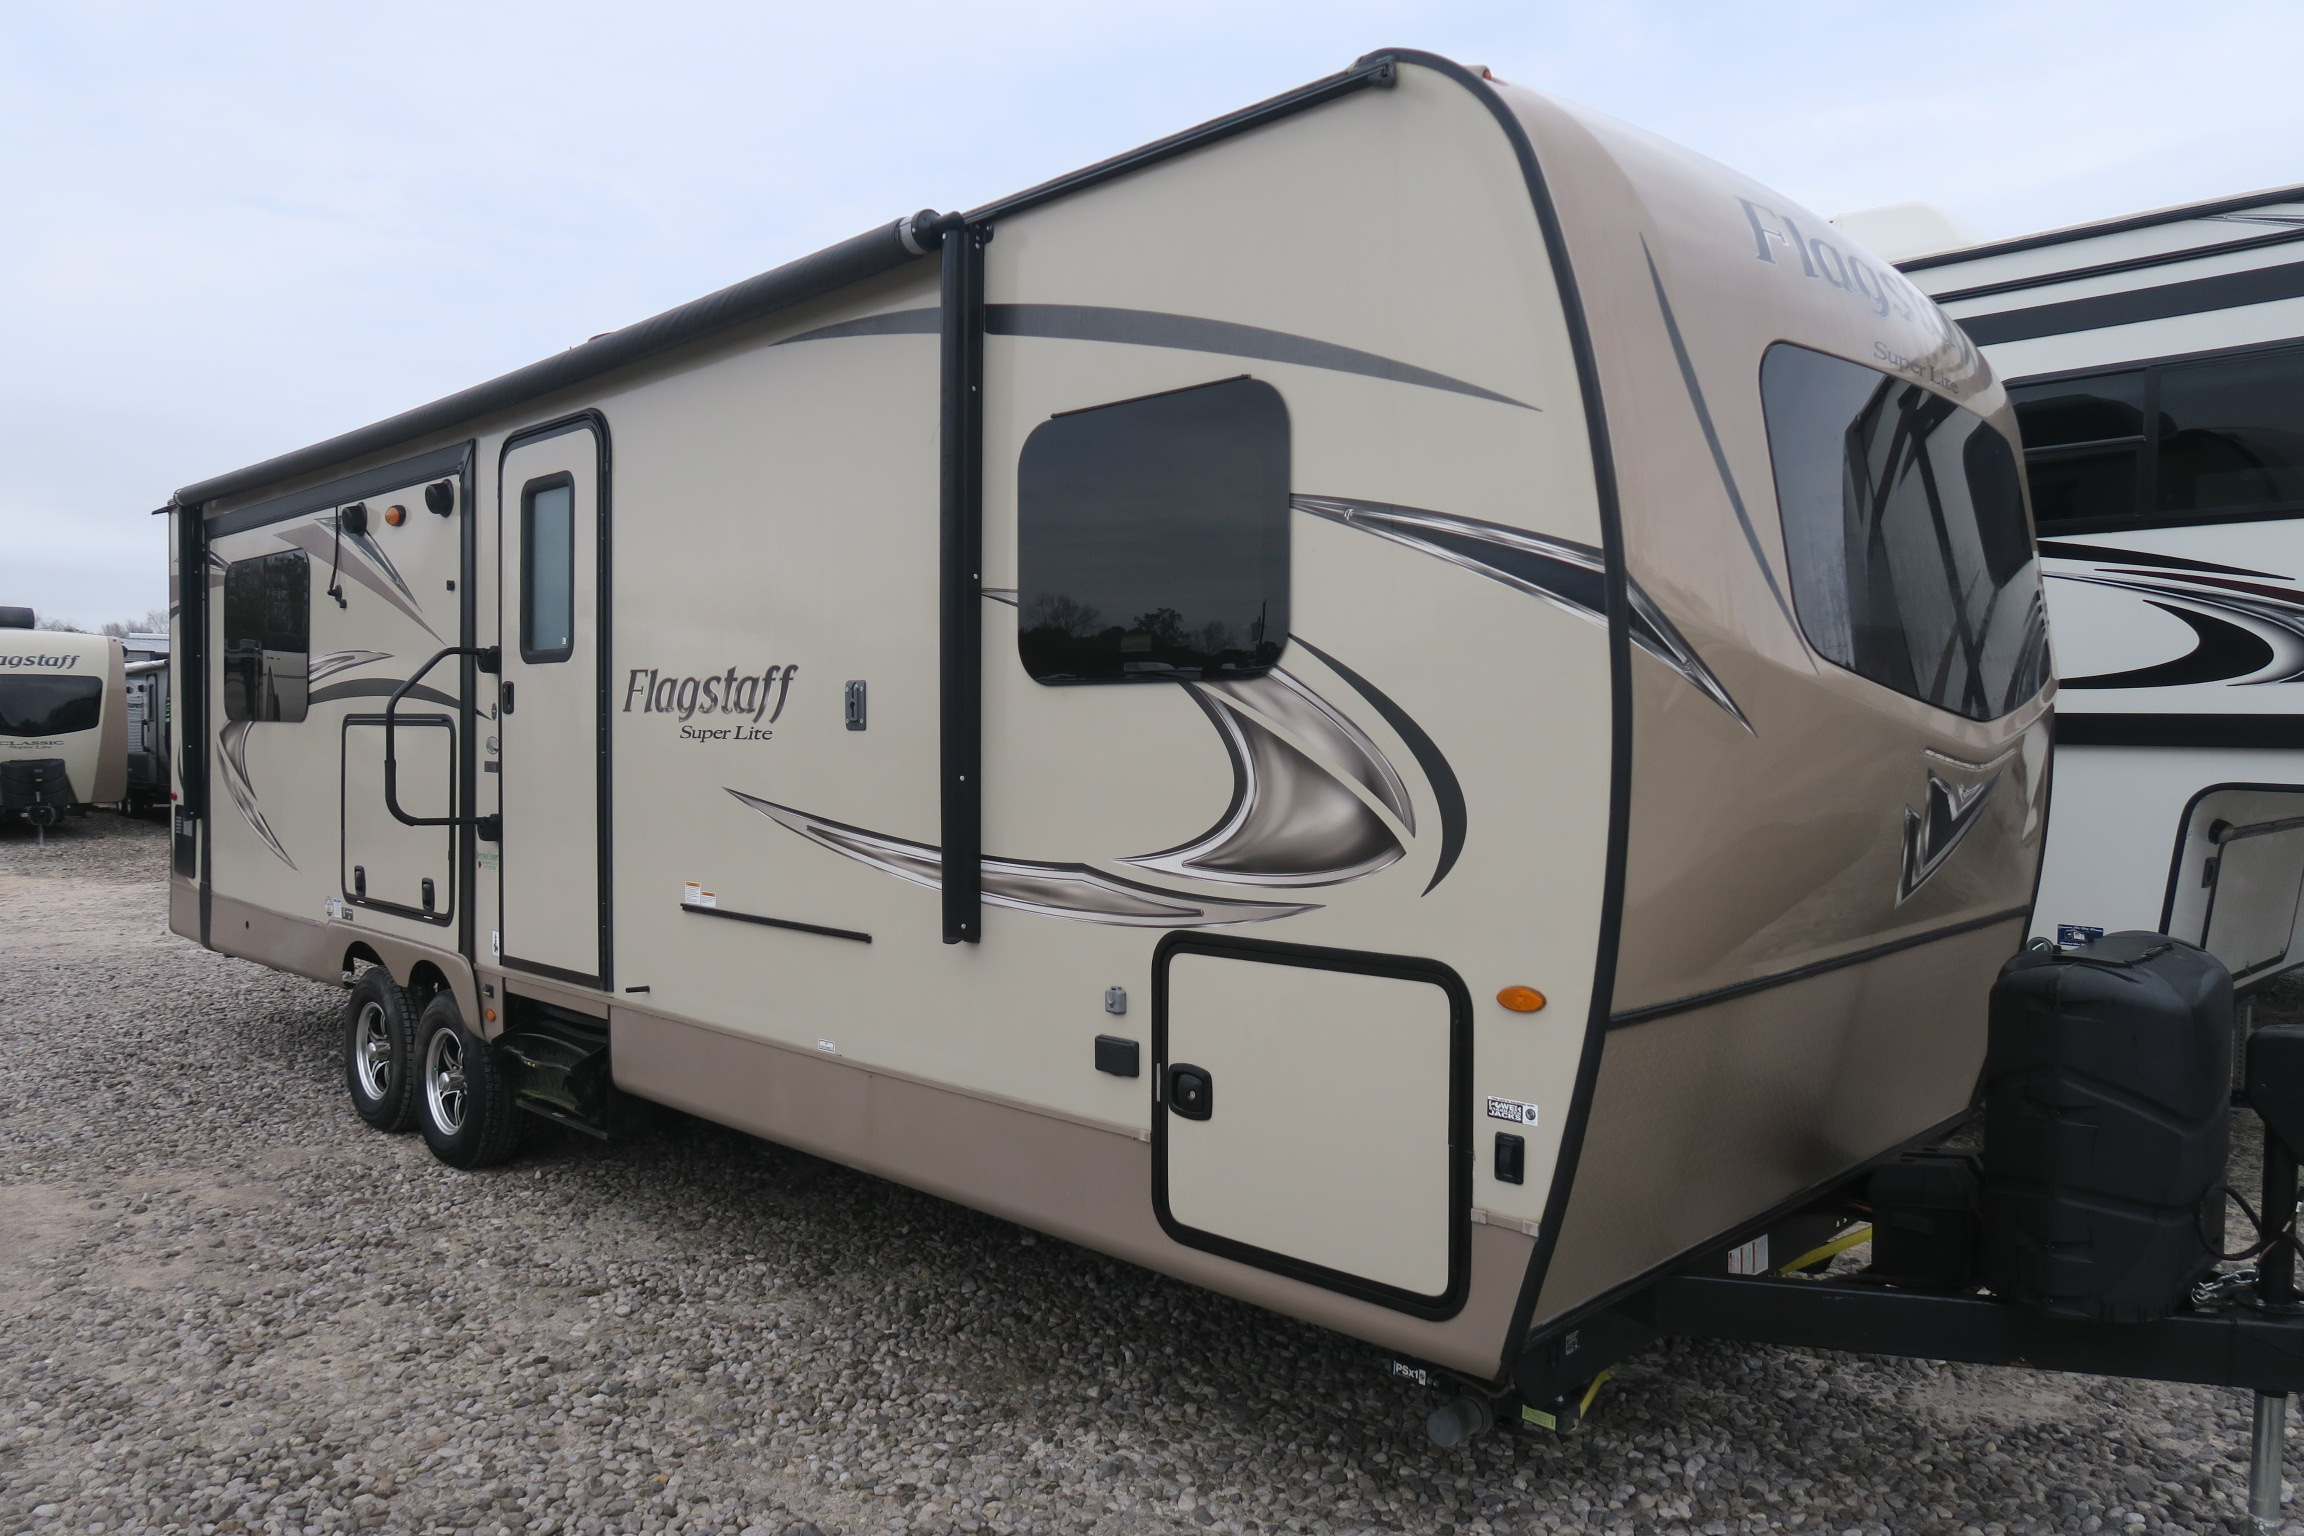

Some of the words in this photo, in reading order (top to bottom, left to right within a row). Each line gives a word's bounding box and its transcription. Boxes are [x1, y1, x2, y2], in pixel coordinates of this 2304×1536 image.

[1873, 341, 1926, 376] Super
[1929, 365, 1959, 394] Lite
[0, 653, 81, 670] agstaff
[622, 664, 799, 724] Flagstaff
[679, 724, 731, 743] Super
[733, 725, 773, 741] Lite
[1488, 1100, 1522, 1113] POWER
[1488, 1110, 1522, 1121] JACKS
